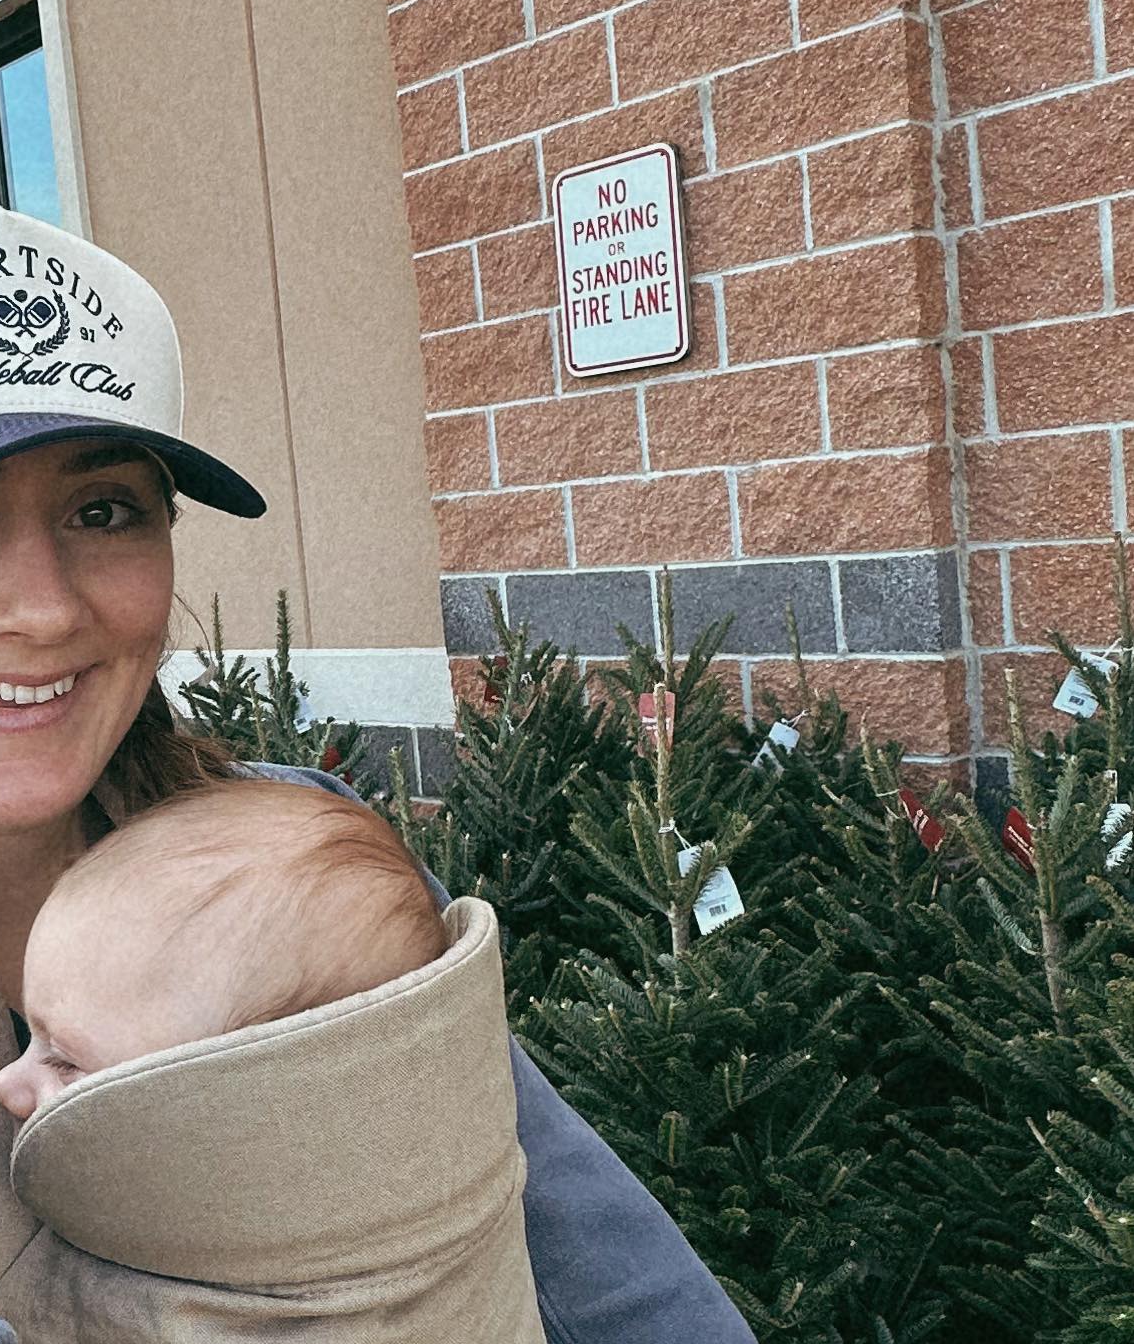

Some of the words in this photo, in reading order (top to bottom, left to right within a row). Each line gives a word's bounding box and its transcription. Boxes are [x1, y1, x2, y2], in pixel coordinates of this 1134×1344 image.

[598, 179, 627, 208] NO
[572, 202, 659, 246] PARKING
[608, 241, 626, 256] OR
[572, 250, 668, 295] STANDING
[572, 293, 613, 330] FIRE
[621, 281, 673, 321] LANE
[70, 363, 136, 402] Club
